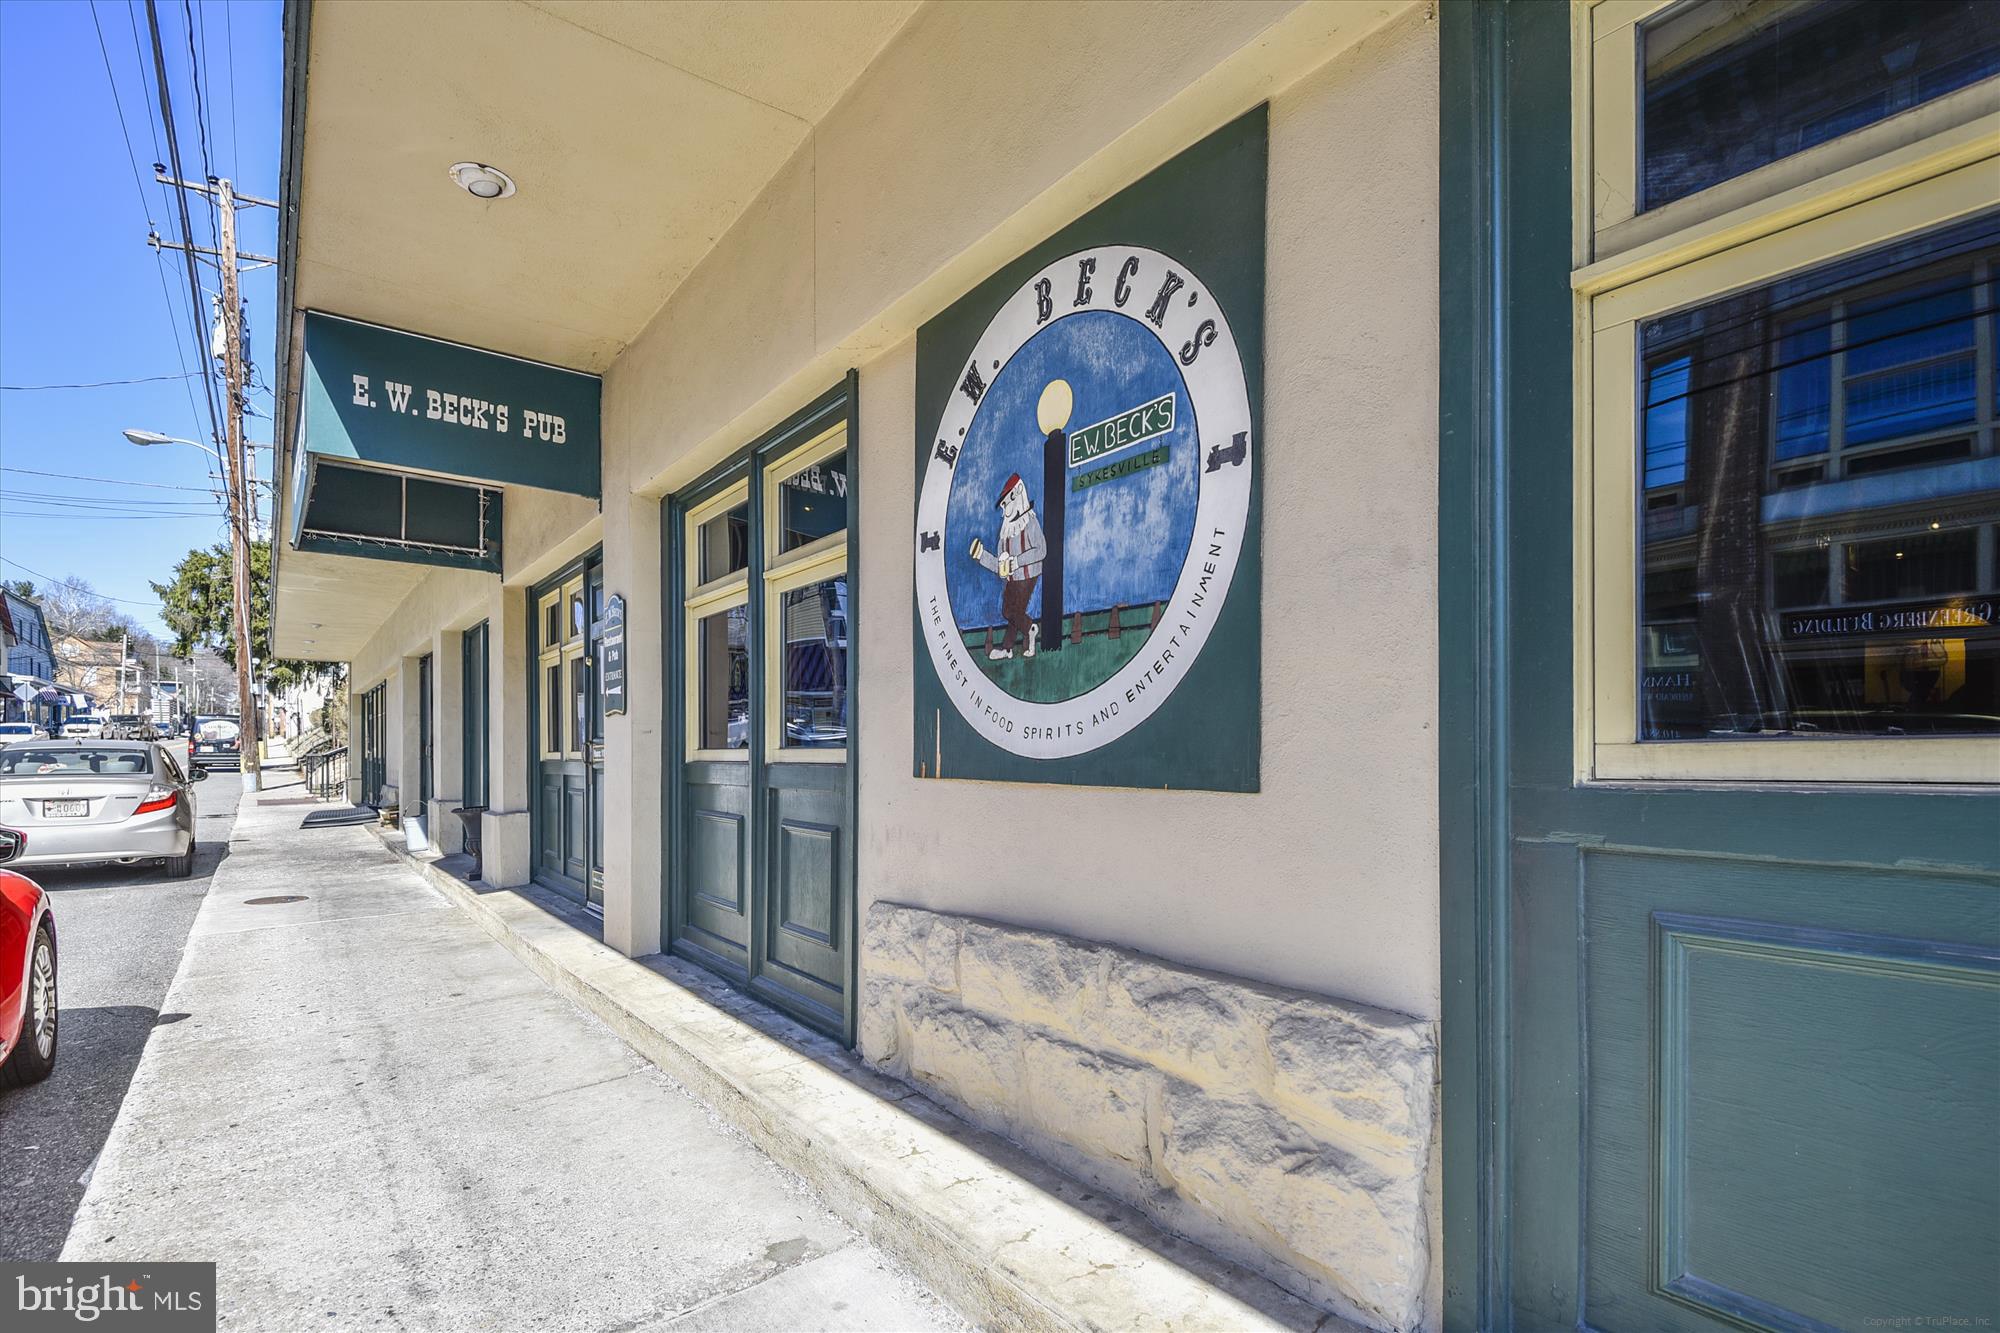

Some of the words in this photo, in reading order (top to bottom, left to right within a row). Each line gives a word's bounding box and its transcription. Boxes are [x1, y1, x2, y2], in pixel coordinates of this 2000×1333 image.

[1034, 256, 1219, 366] BECK'S
[352, 374, 376, 408] E.
[385, 380, 418, 416] W.
[426, 389, 509, 433] BECK'S
[523, 409, 567, 444] PUB
[1104, 400, 1172, 449] BECK'S
[1079, 450, 1160, 488] SYKESVILLE
[929, 595, 942, 626] THE
[938, 631, 969, 689] FINEST
[970, 690, 984, 709] IN
[985, 704, 1014, 734] FOOD
[1023, 721, 1085, 740] SPIRITS
[1092, 701, 1121, 728] AND
[1125, 527, 1227, 704] ENTERTAINMENT
